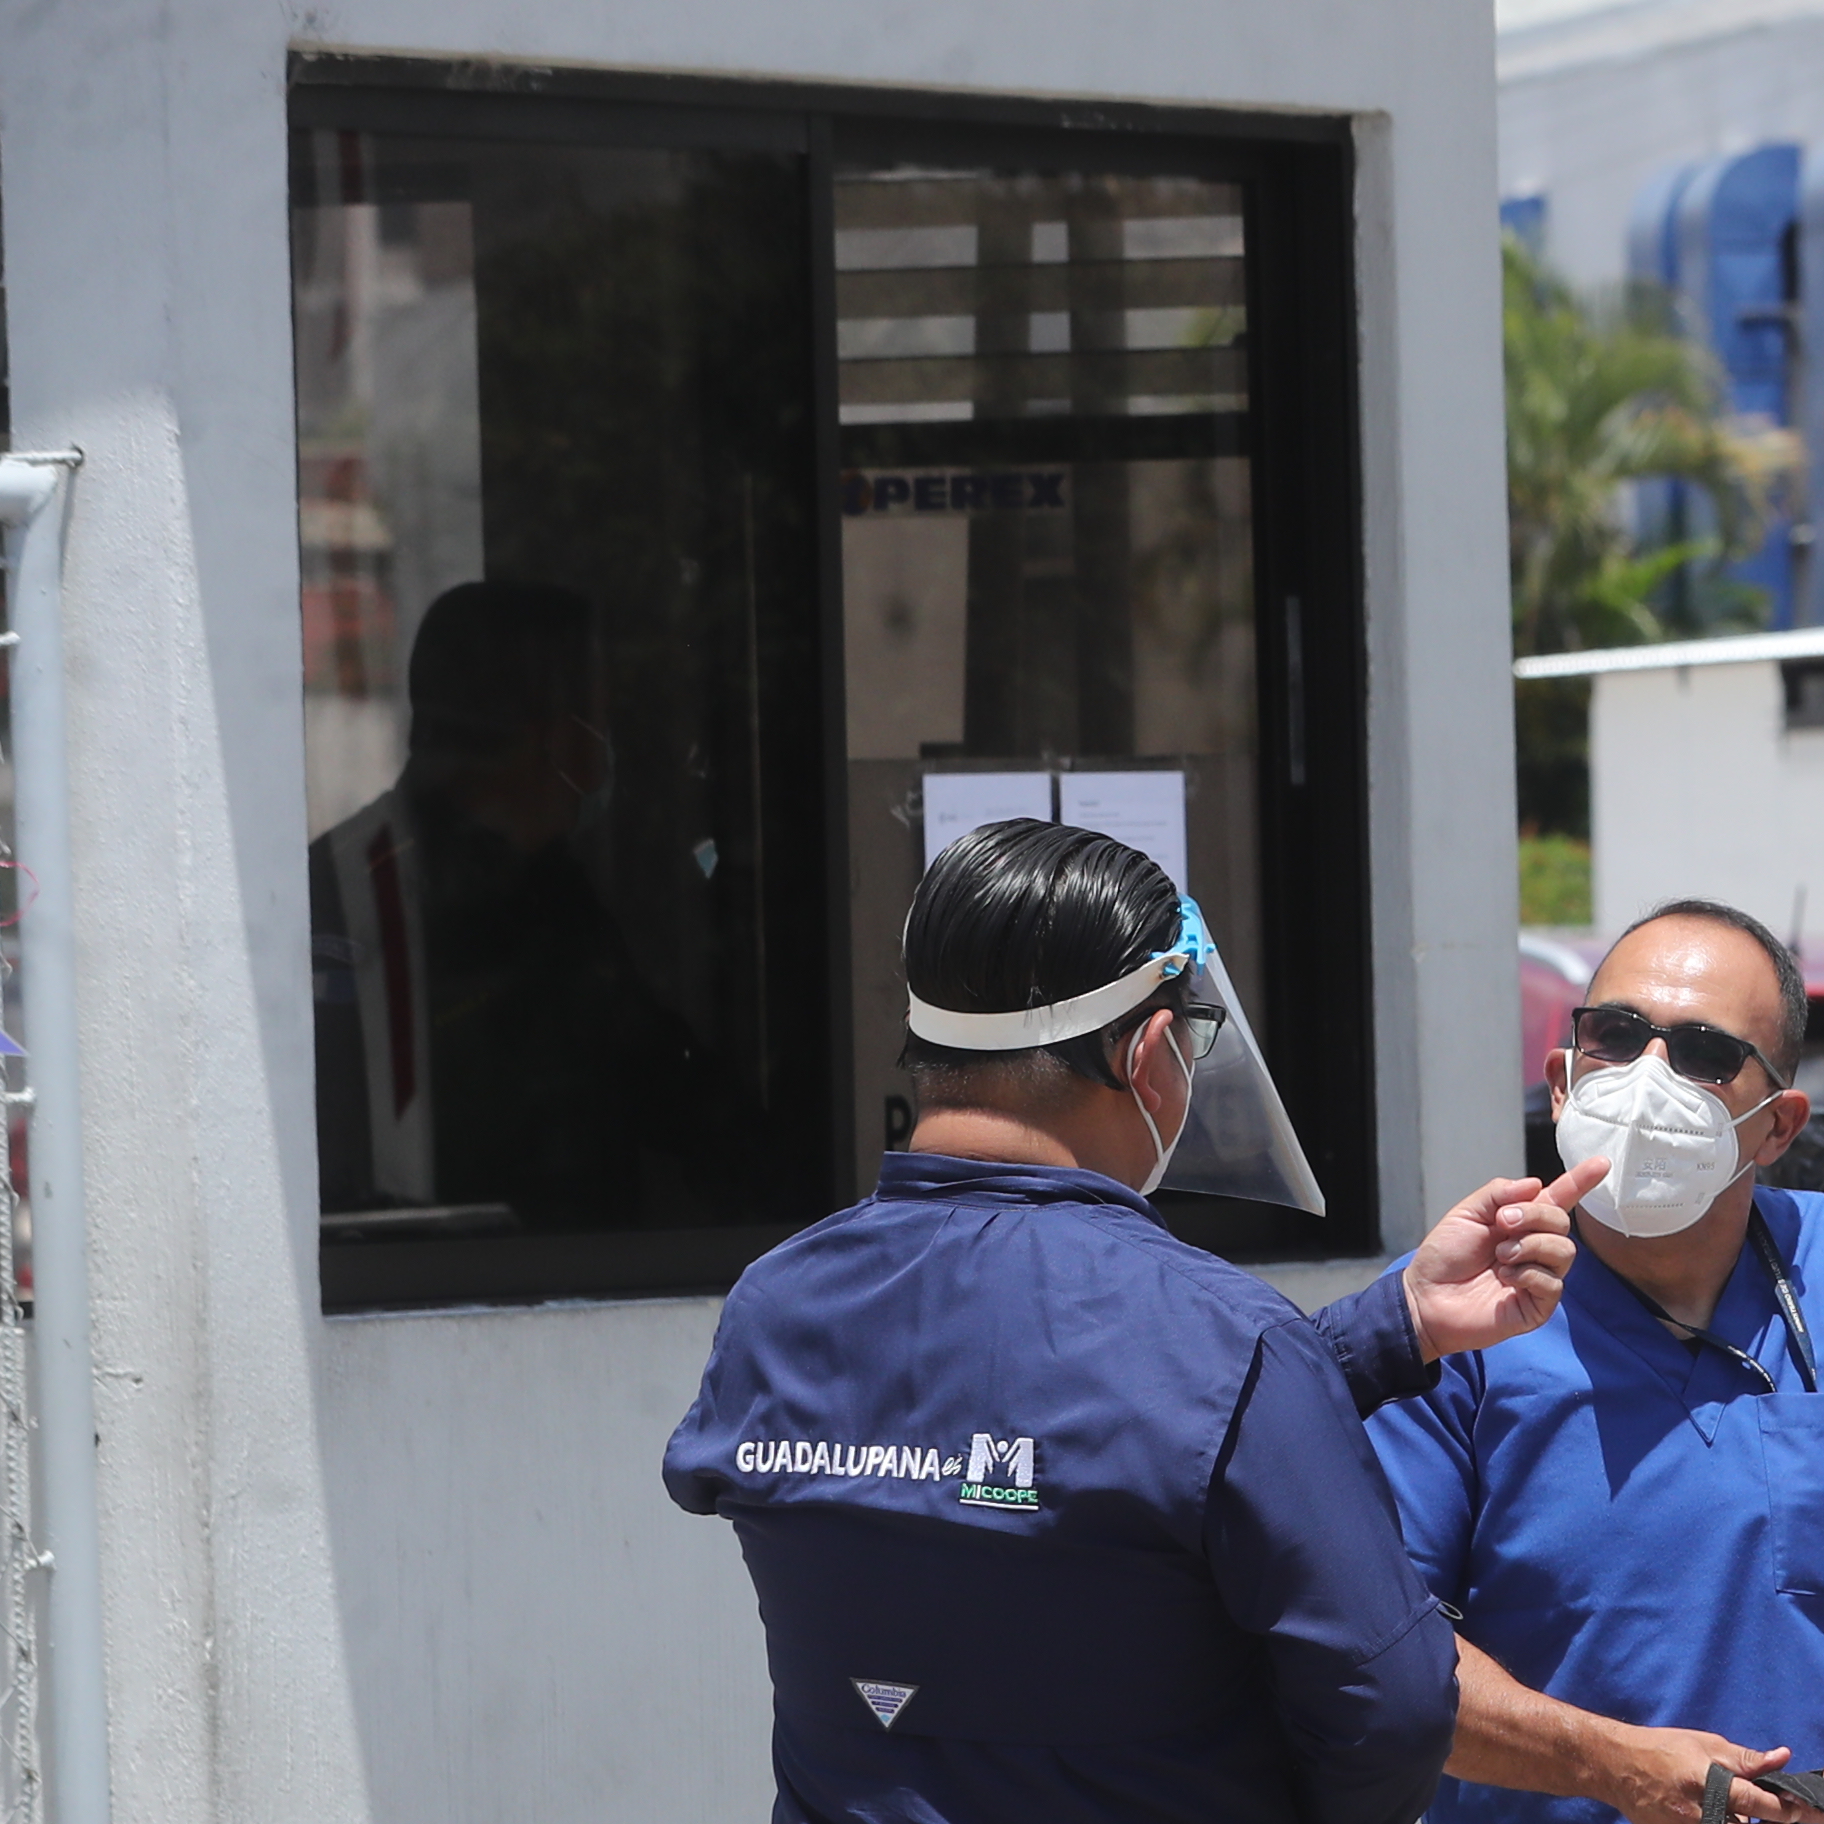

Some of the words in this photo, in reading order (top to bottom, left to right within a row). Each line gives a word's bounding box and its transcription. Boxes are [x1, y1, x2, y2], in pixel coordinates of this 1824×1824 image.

[735, 1440, 941, 1482] GUADALUPANA
[959, 1482, 1039, 1504] MICOOPE
[861, 1683, 907, 1699] Columbia
